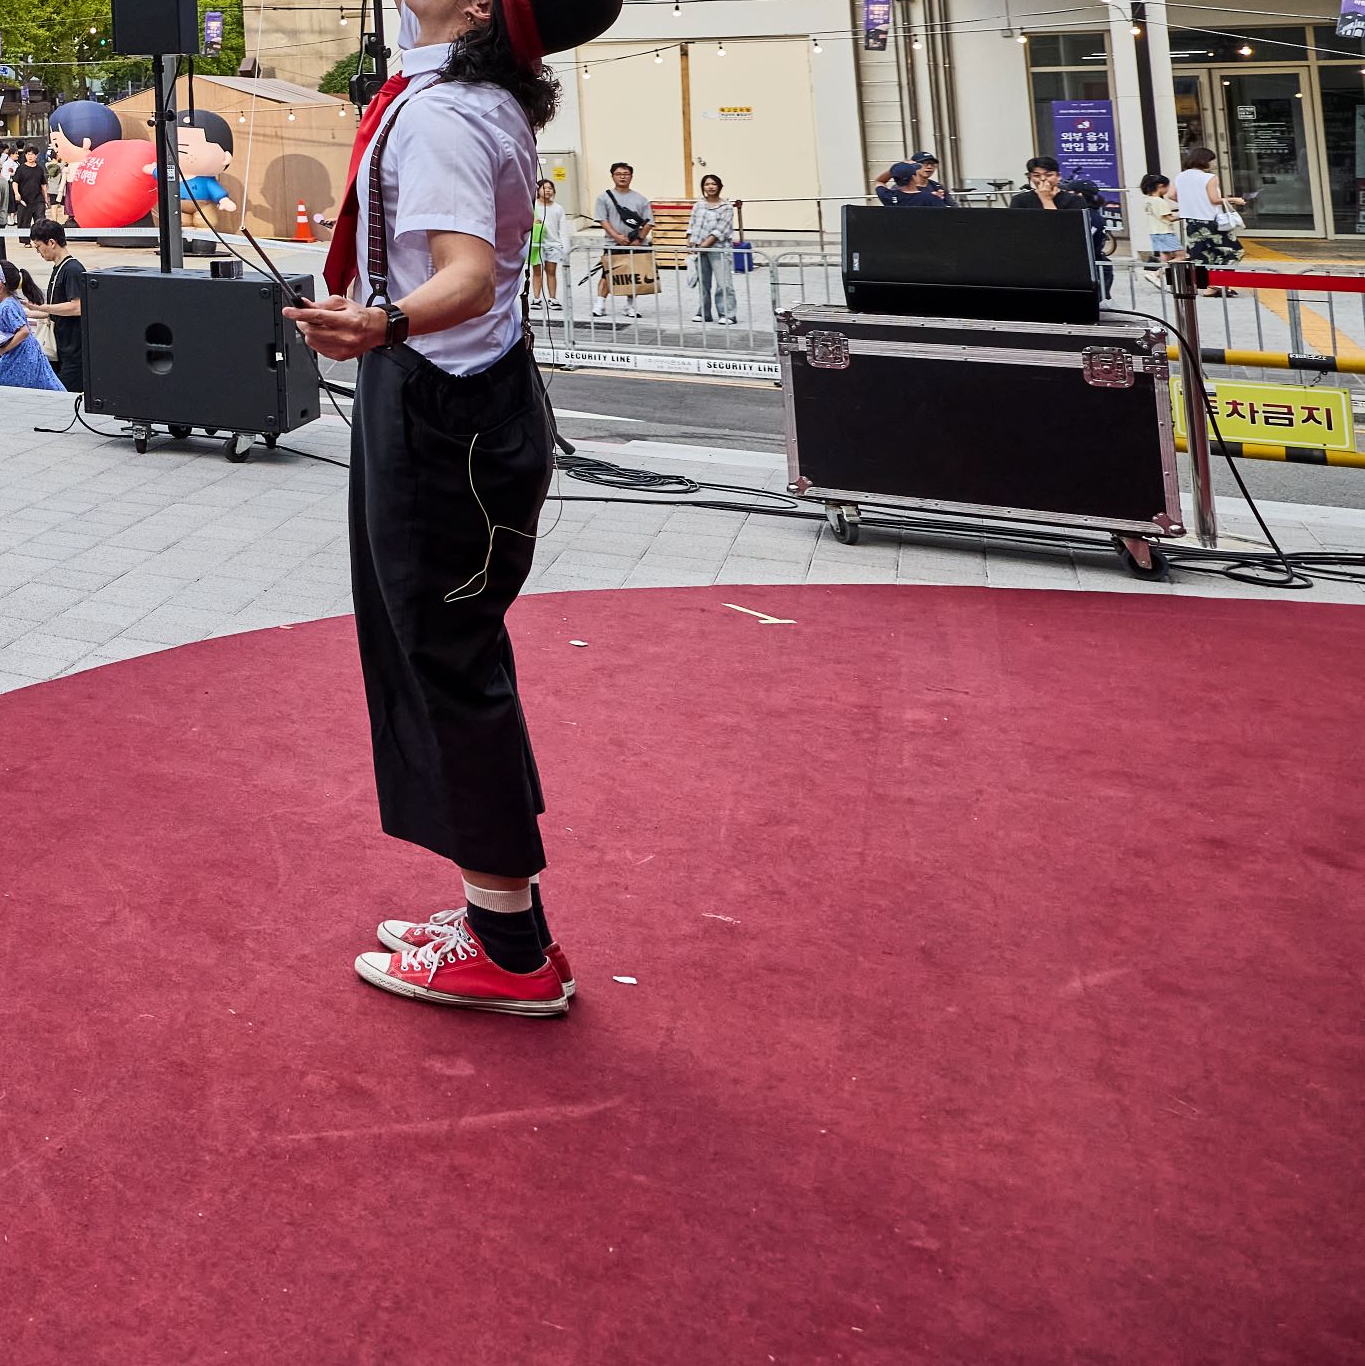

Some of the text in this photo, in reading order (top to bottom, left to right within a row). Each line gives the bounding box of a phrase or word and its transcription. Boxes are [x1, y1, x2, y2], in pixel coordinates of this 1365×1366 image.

[1060, 132, 1083, 141] 외부
[612, 274, 641, 286] NIKE
[565, 351, 631, 364] SECURITY LINE
[706, 361, 780, 374] SECURITY LINE
